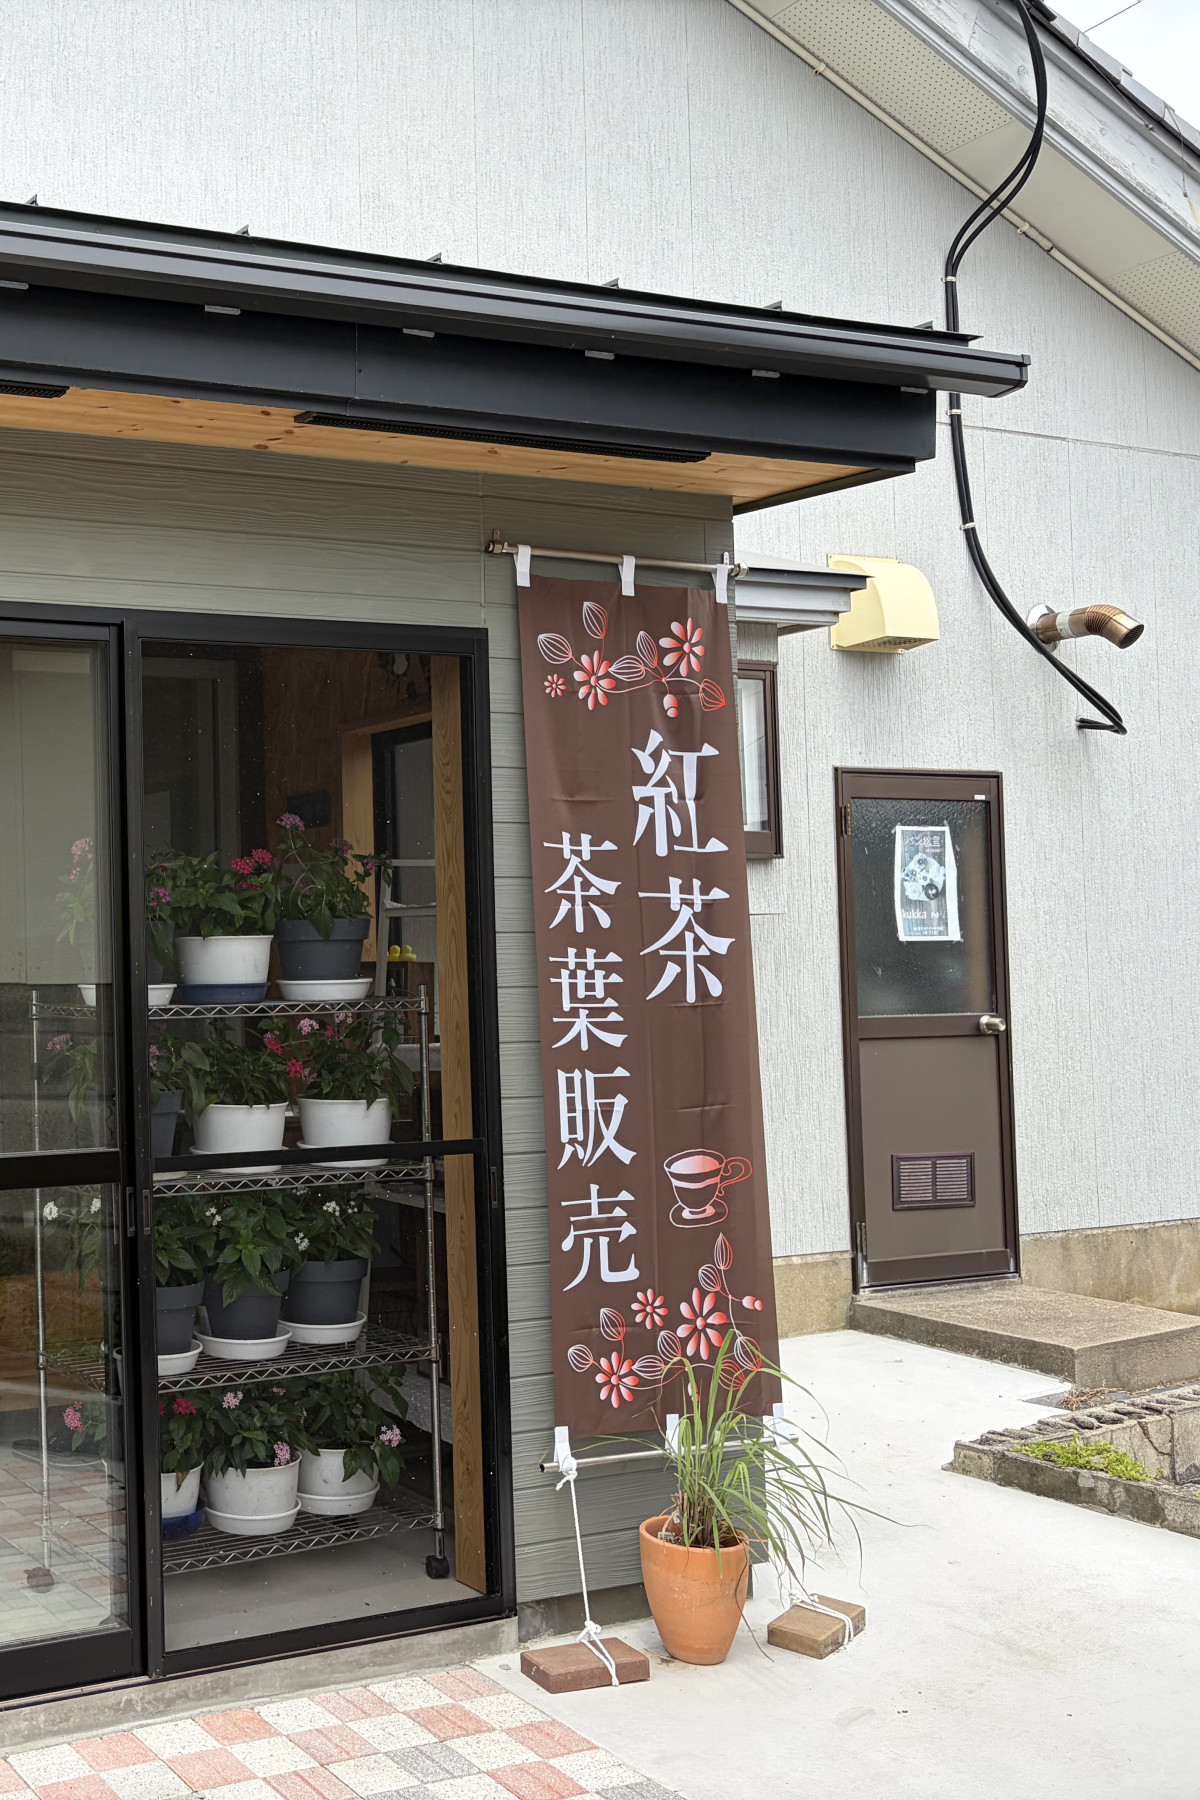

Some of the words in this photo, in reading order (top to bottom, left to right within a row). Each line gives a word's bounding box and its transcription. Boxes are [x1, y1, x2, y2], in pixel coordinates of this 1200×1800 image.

[631, 728, 736, 1004] 紅茶
[902, 908, 927, 919] kukka
[542, 830, 641, 1293] 茶葉販売
